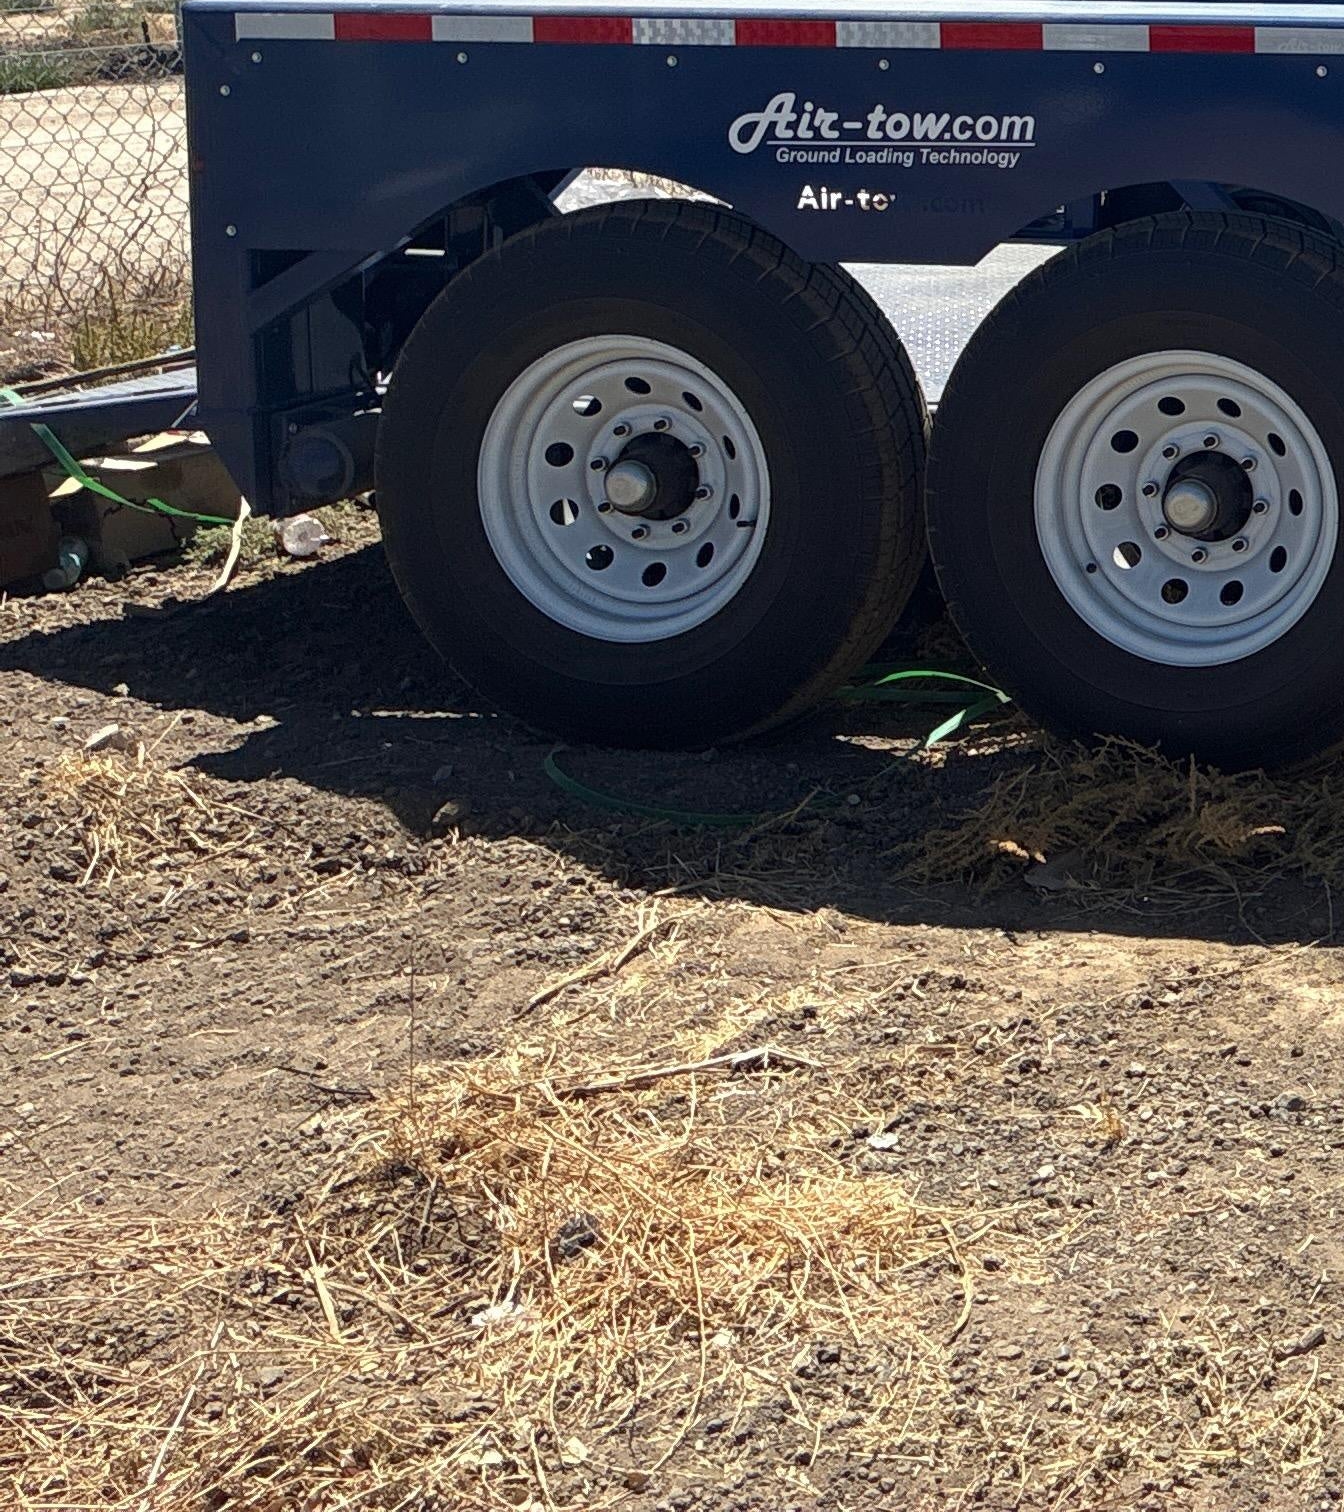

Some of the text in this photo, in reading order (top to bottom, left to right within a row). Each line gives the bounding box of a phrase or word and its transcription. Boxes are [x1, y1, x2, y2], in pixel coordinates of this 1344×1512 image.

[729, 92, 1036, 155] Air-tow.com
[775, 147, 1020, 169] Ground Loading Technology
